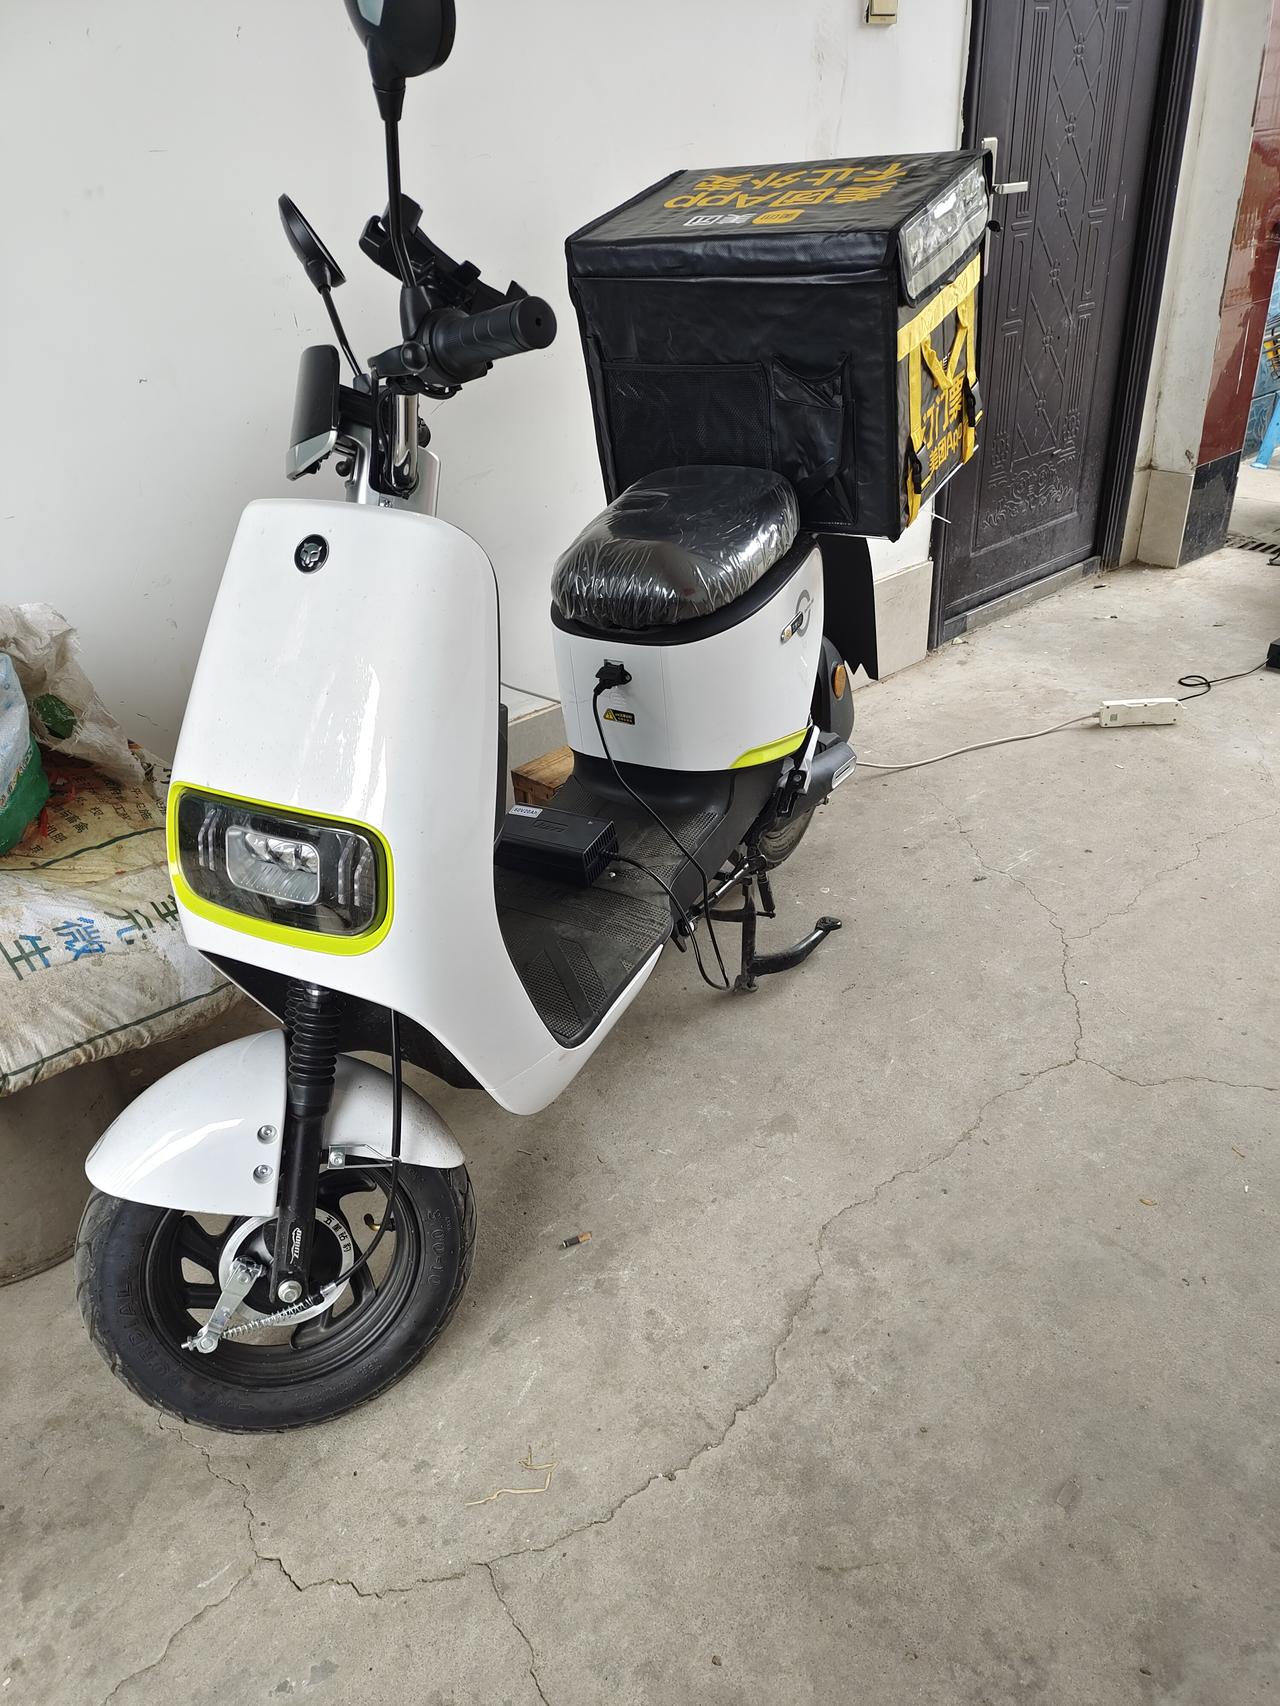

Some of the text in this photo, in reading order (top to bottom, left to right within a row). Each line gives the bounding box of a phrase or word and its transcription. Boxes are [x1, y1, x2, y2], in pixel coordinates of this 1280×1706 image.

[693, 162, 908, 191] 不止外卖
[683, 213, 758, 226] 美团
